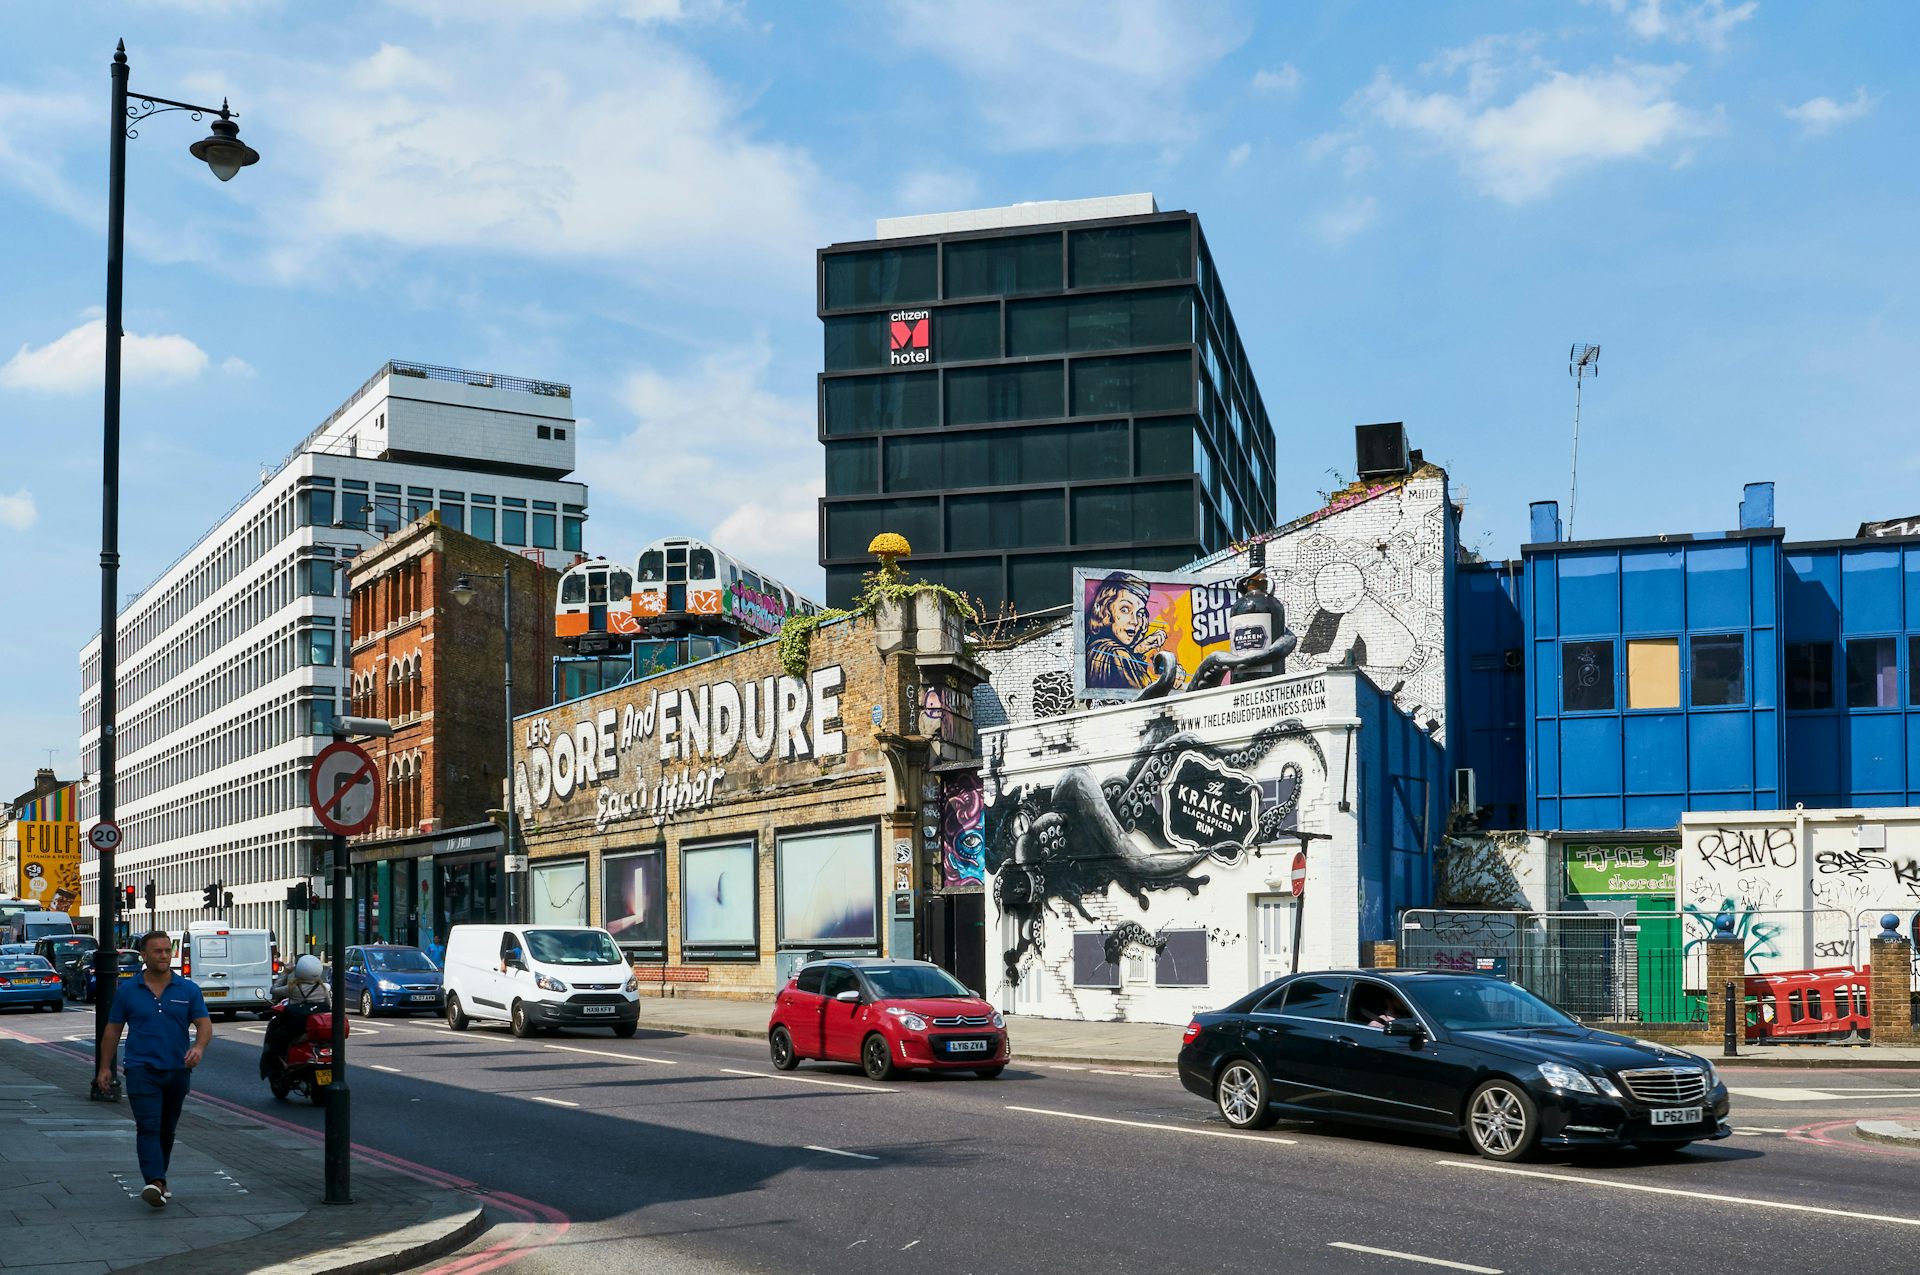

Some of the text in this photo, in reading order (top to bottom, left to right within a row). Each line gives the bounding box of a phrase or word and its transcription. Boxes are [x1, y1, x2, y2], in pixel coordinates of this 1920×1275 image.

[891, 310, 929, 321] citizen
[890, 348, 929, 365] hotel
[1191, 577, 1244, 615] BUY
[1233, 679, 1326, 708] #RELEASETHEKRAKEN
[514, 708, 619, 822] ADORE
[659, 665, 847, 763] ENDURE
[526, 717, 551, 749] LETS
[1204, 781, 1225, 797] The
[1178, 784, 1244, 826] KRAKEN
[1182, 805, 1233, 833] BLACK SPICED
[1195, 821, 1215, 838] RUM
[94, 830, 117, 842] 20
[1576, 846, 1649, 873] THE
[1656, 1110, 1683, 1123] LP62
